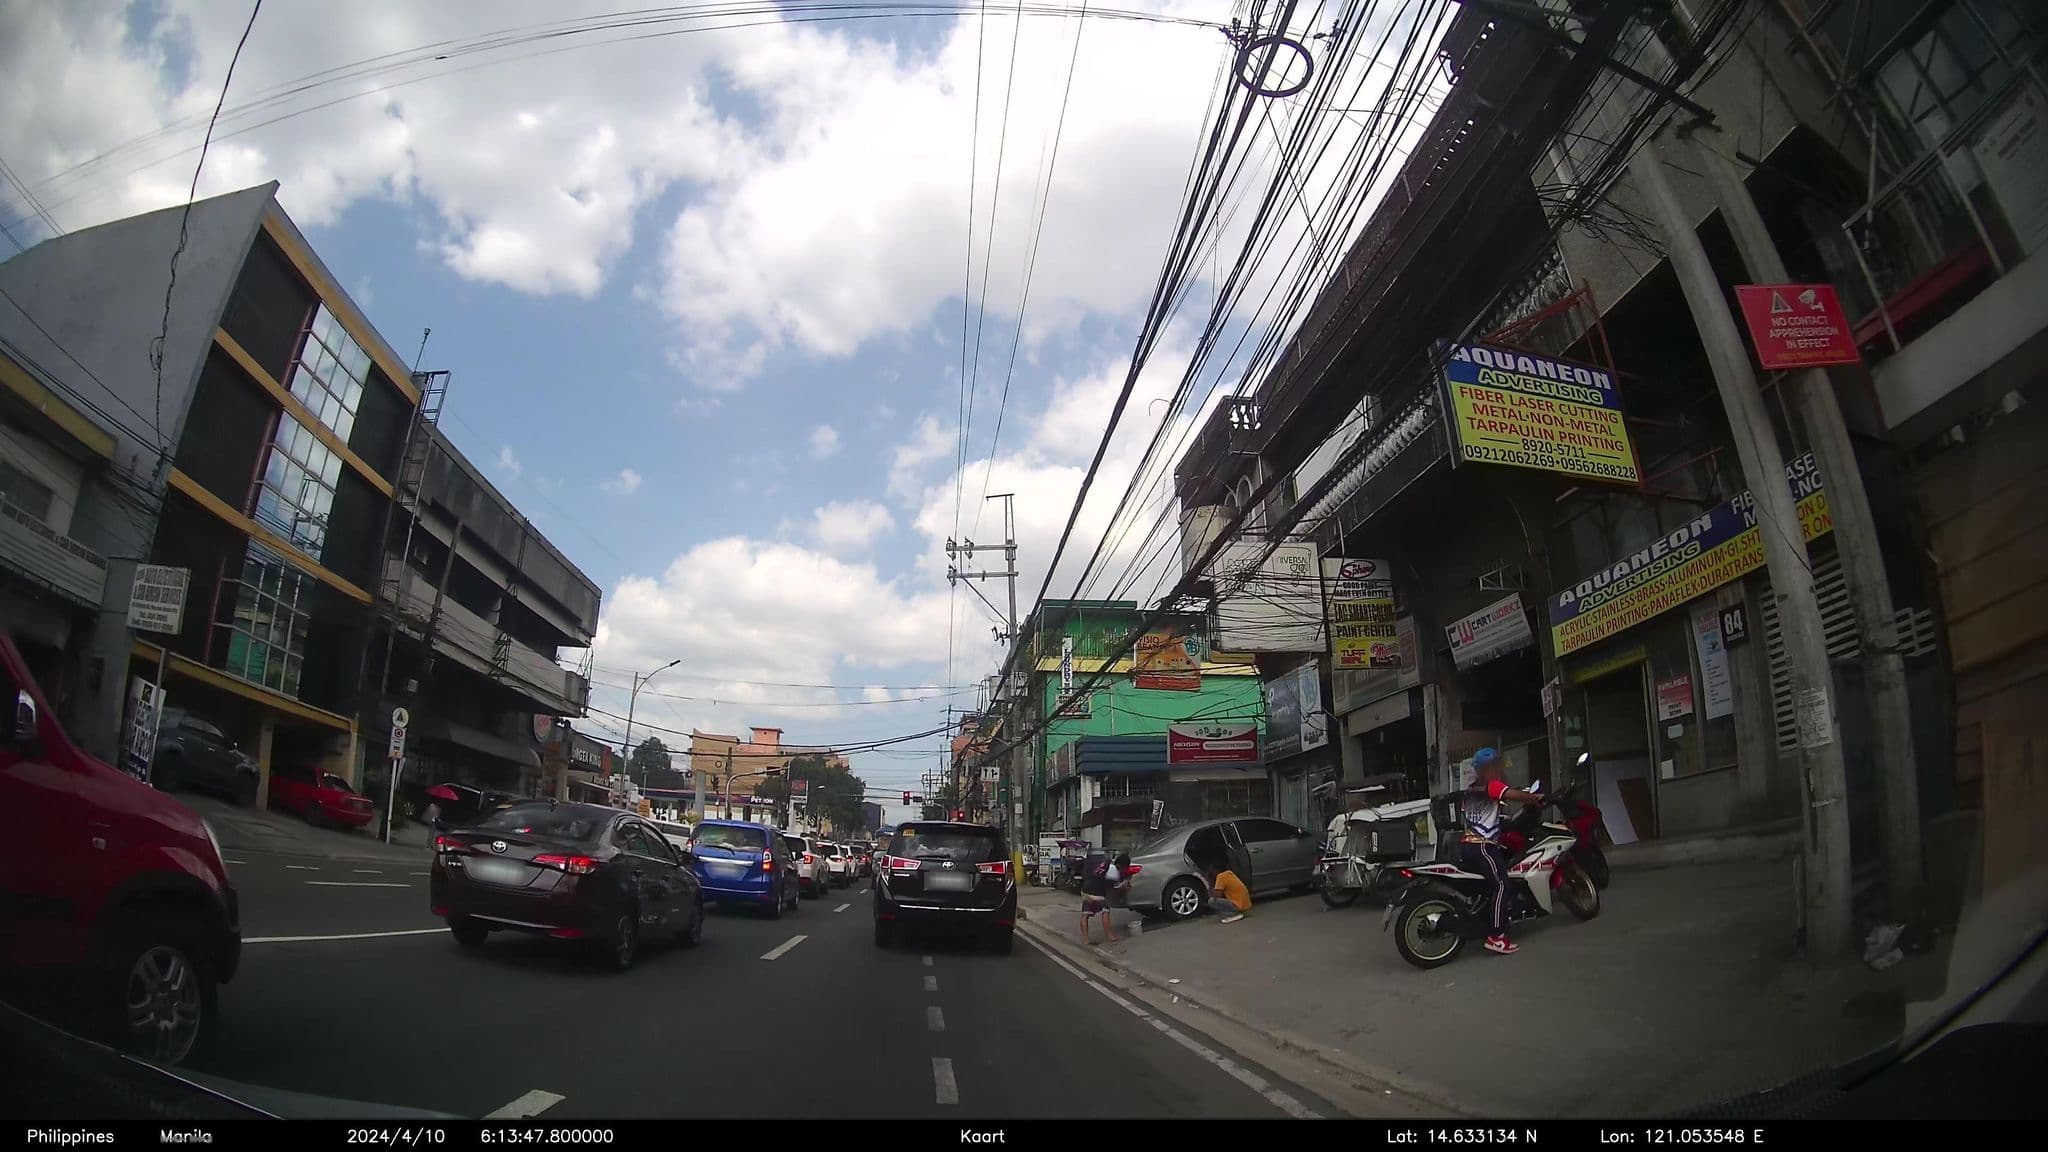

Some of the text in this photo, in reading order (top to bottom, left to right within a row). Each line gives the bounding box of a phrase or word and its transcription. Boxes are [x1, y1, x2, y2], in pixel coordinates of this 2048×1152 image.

[1769, 327, 1840, 338] APPREHENSION
[1771, 315, 1828, 327] NO CONTACT
[1785, 338, 1830, 349] IN EFFECT
[1450, 343, 1612, 390] AQUANEON
[1479, 369, 1603, 404] ADVERTISING
[1459, 386, 1619, 424] FIBER LASER CUTTING
[1467, 416, 1624, 452] TARPAULIN PRINTING
[1522, 439, 1587, 458] 8920-5711
[1731, 453, 1816, 515] FIB ASE
[1559, 513, 1713, 607] AQUANEON
[1579, 541, 1700, 613] ADVERTISING
[1336, 625, 1397, 638] PAINT CENTER
[1723, 608, 1744, 635] 84
[1561, 625, 1605, 652] TARPAULIN
